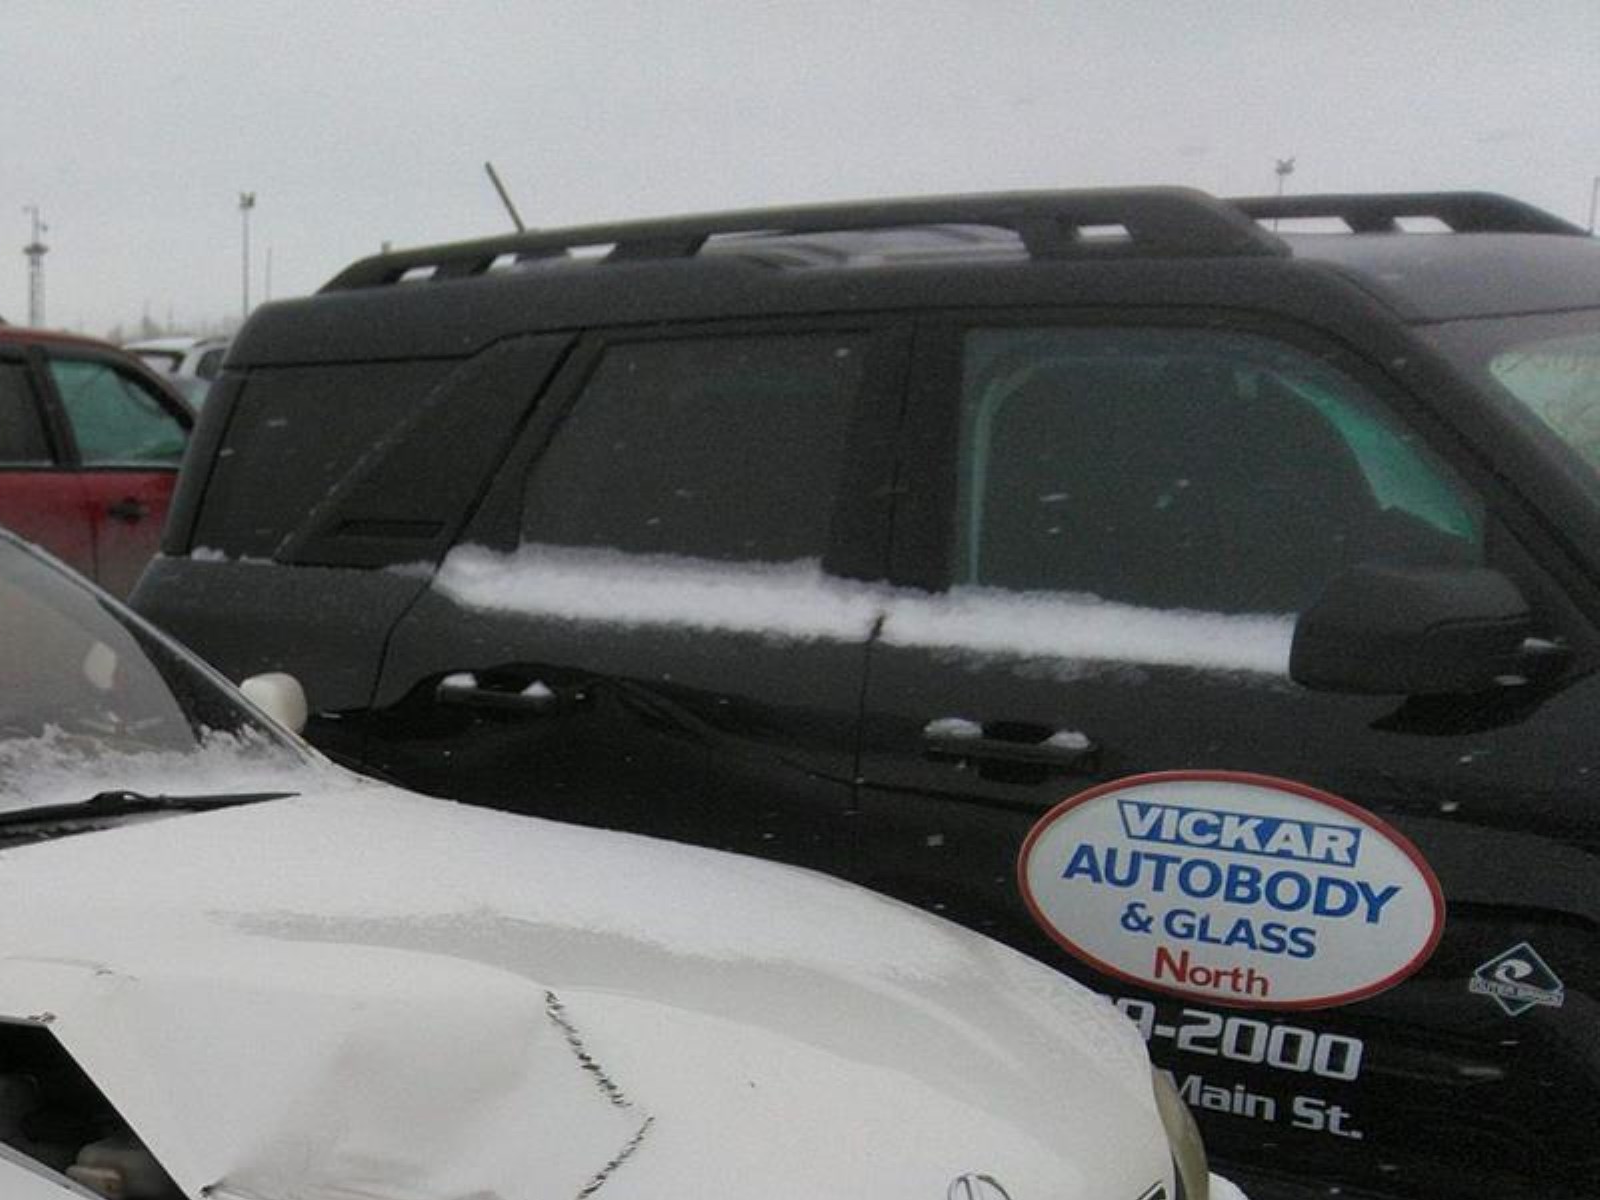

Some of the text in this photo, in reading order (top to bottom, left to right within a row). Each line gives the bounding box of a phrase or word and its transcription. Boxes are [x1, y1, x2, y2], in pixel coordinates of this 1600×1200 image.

[1120, 802, 1358, 865] VICKAR
[1061, 843, 1403, 924] AUTOBODY
[1120, 902, 1317, 960] & GLASS
[1153, 946, 1271, 998] North
[1103, 995, 1364, 1082] 9-2000
[1291, 1094, 1364, 1140] St.
